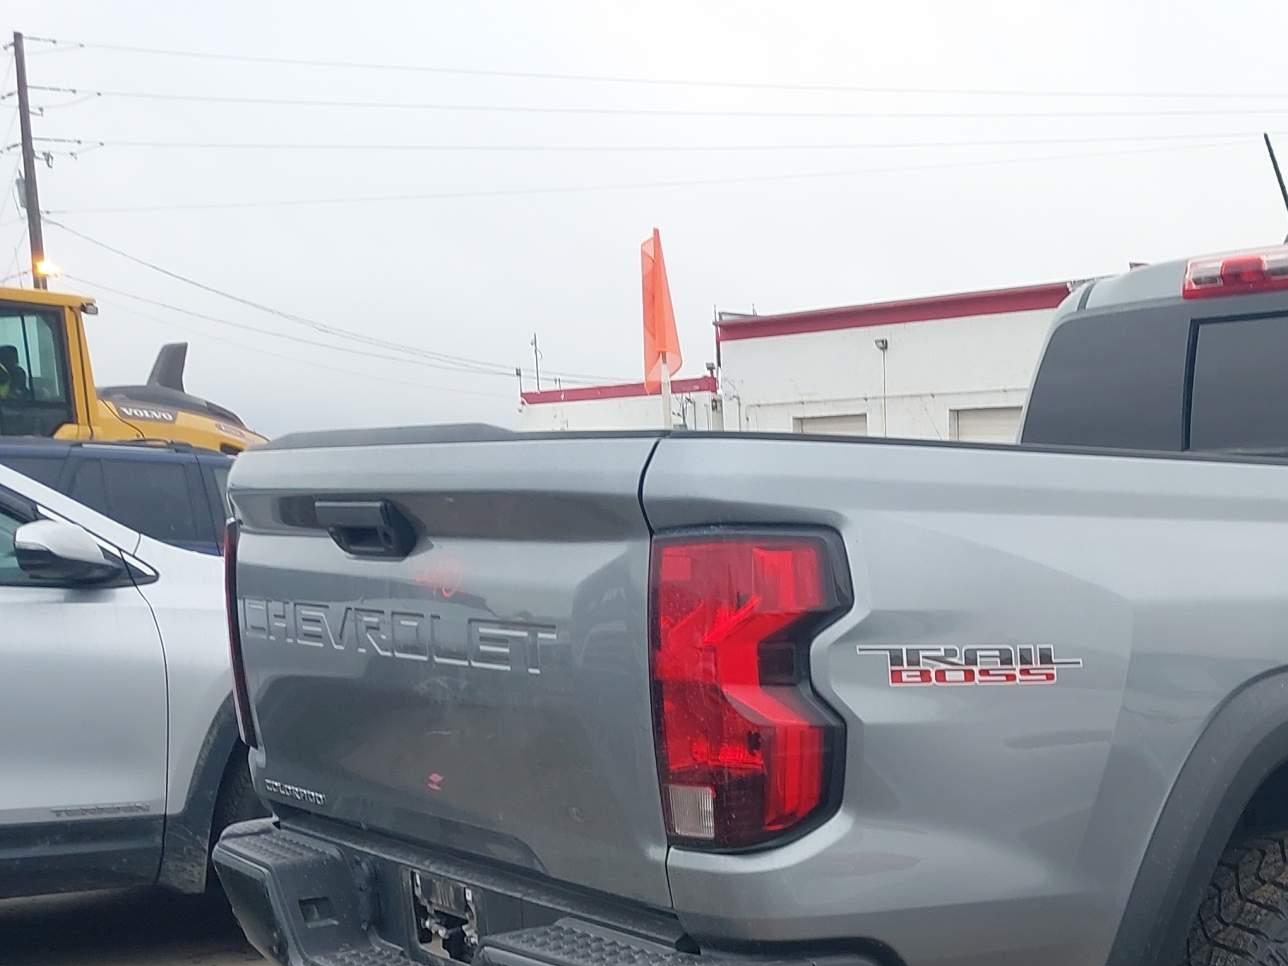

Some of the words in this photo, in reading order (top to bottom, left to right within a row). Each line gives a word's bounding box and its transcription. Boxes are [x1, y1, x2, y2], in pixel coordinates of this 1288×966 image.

[120, 406, 173, 421] VOLVO
[242, 597, 558, 675] CHEVROLET
[856, 644, 1083, 668] TRAIL
[889, 666, 1057, 687] BOSS
